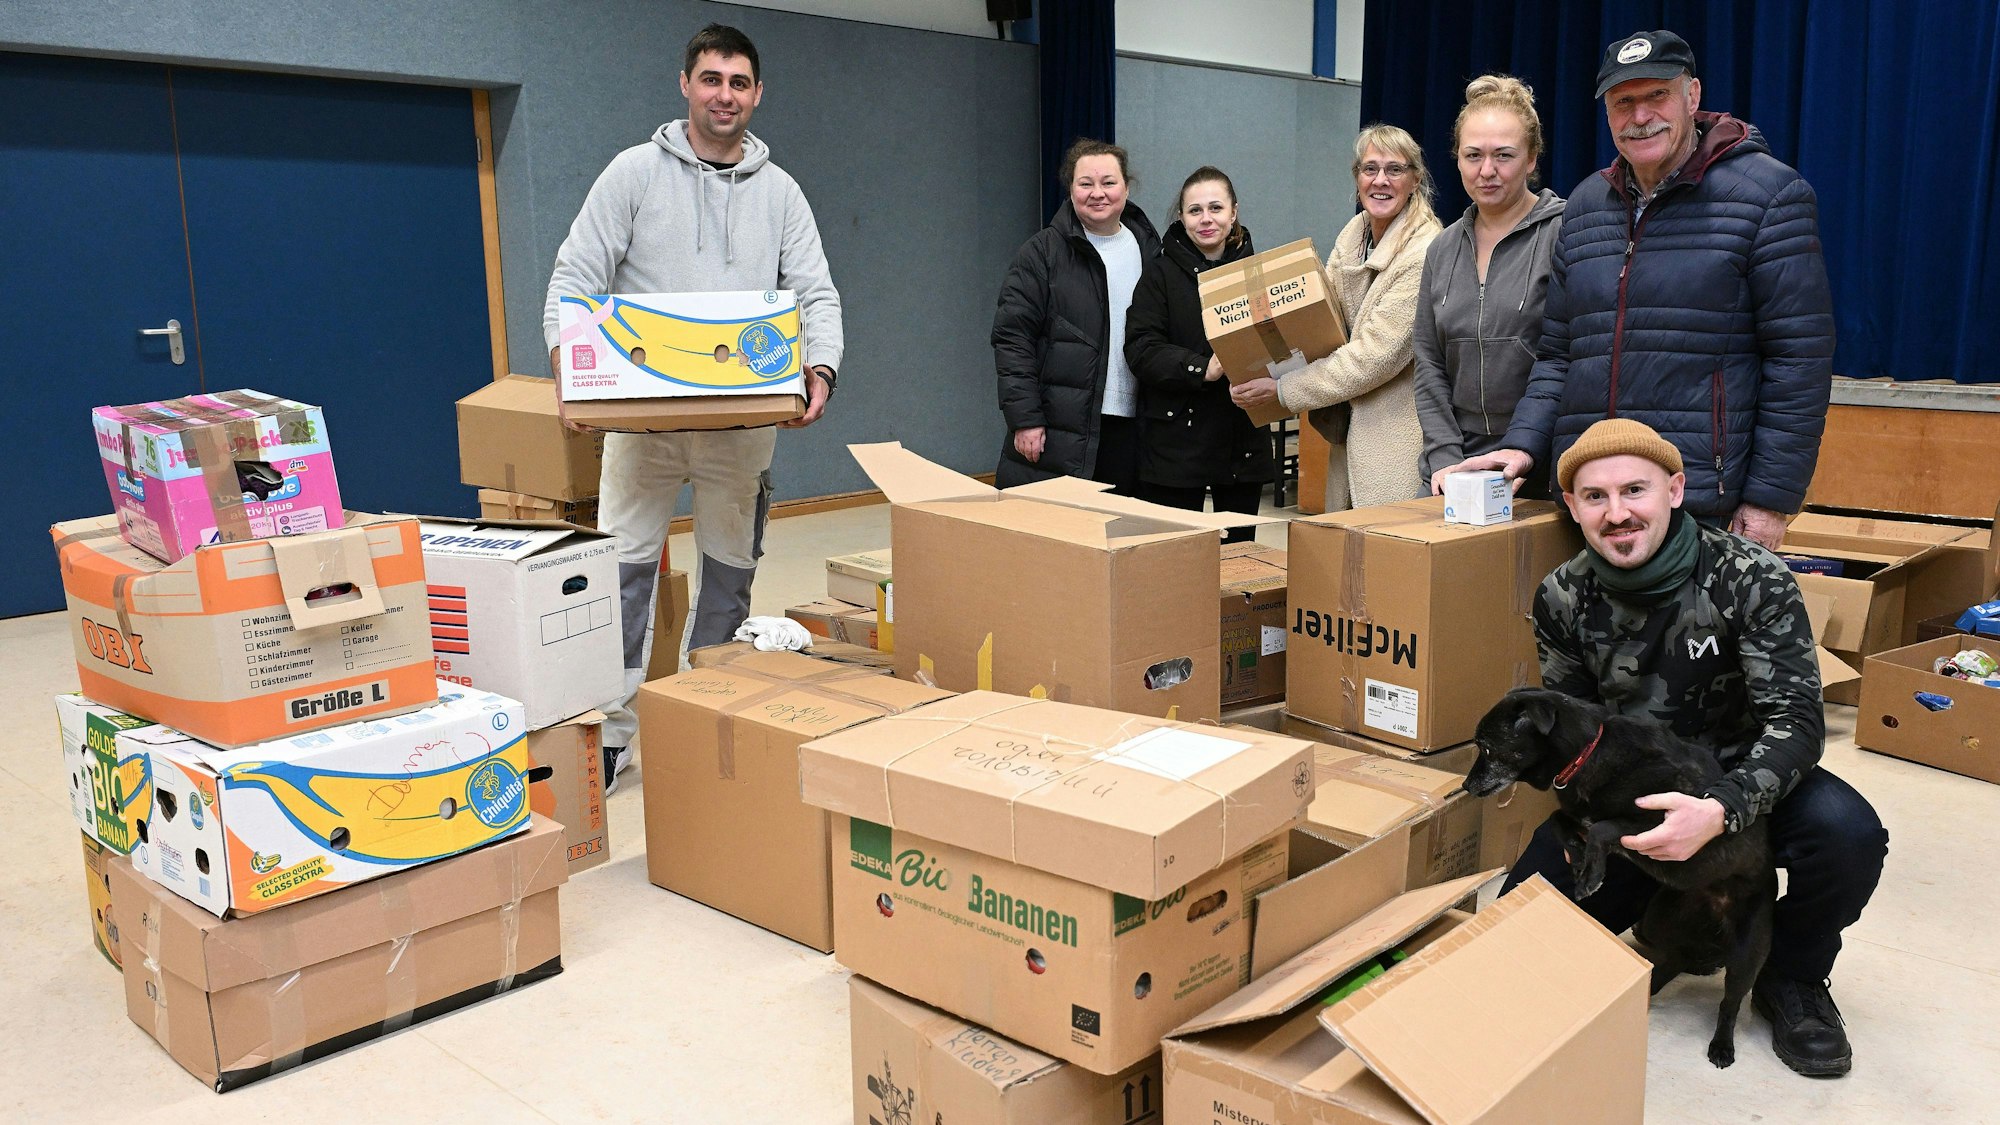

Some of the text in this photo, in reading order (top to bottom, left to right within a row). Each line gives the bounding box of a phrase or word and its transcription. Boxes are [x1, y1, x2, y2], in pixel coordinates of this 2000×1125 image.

[1214, 295, 1249, 315] Vorsi
[1269, 280, 1299, 296] Glas
[1269, 288, 1306, 309] erfen!
[749, 342, 791, 374] Chiquita
[572, 379, 617, 388] CLASS EXTRA
[233, 429, 283, 451] Pack
[289, 460, 305, 469] dm
[266, 501, 294, 516] plus
[430, 535, 530, 550] OPENEN
[527, 552, 582, 573] VERVANGINGSWAARDE
[1252, 601, 1282, 611] PRODUCT
[254, 625, 296, 638] Esszimme
[351, 622, 373, 634] Keller
[1223, 628, 1251, 640] ANIC
[1292, 607, 1417, 669] McFilter
[82, 616, 153, 675] OBI
[256, 640, 282, 650] Küche
[352, 634, 379, 645] Garage
[1220, 635, 1260, 653] NAN
[257, 647, 312, 663] Schlafzimmer
[259, 658, 314, 675] Kinderzimmer
[261, 672, 313, 687] Gästezimmer
[291, 684, 385, 719] Größe L
[87, 727, 117, 759] GOLDE
[480, 778, 524, 825] Chiquita
[97, 817, 129, 852] BANAN
[567, 836, 602, 862] BI
[850, 850, 892, 874] EDEKA
[256, 857, 322, 891] SELECTED QUALITY
[262, 866, 325, 899] CLASS EXTRA
[895, 849, 1078, 948] Bio Bananen
[957, 1026, 1018, 1066] Herren
